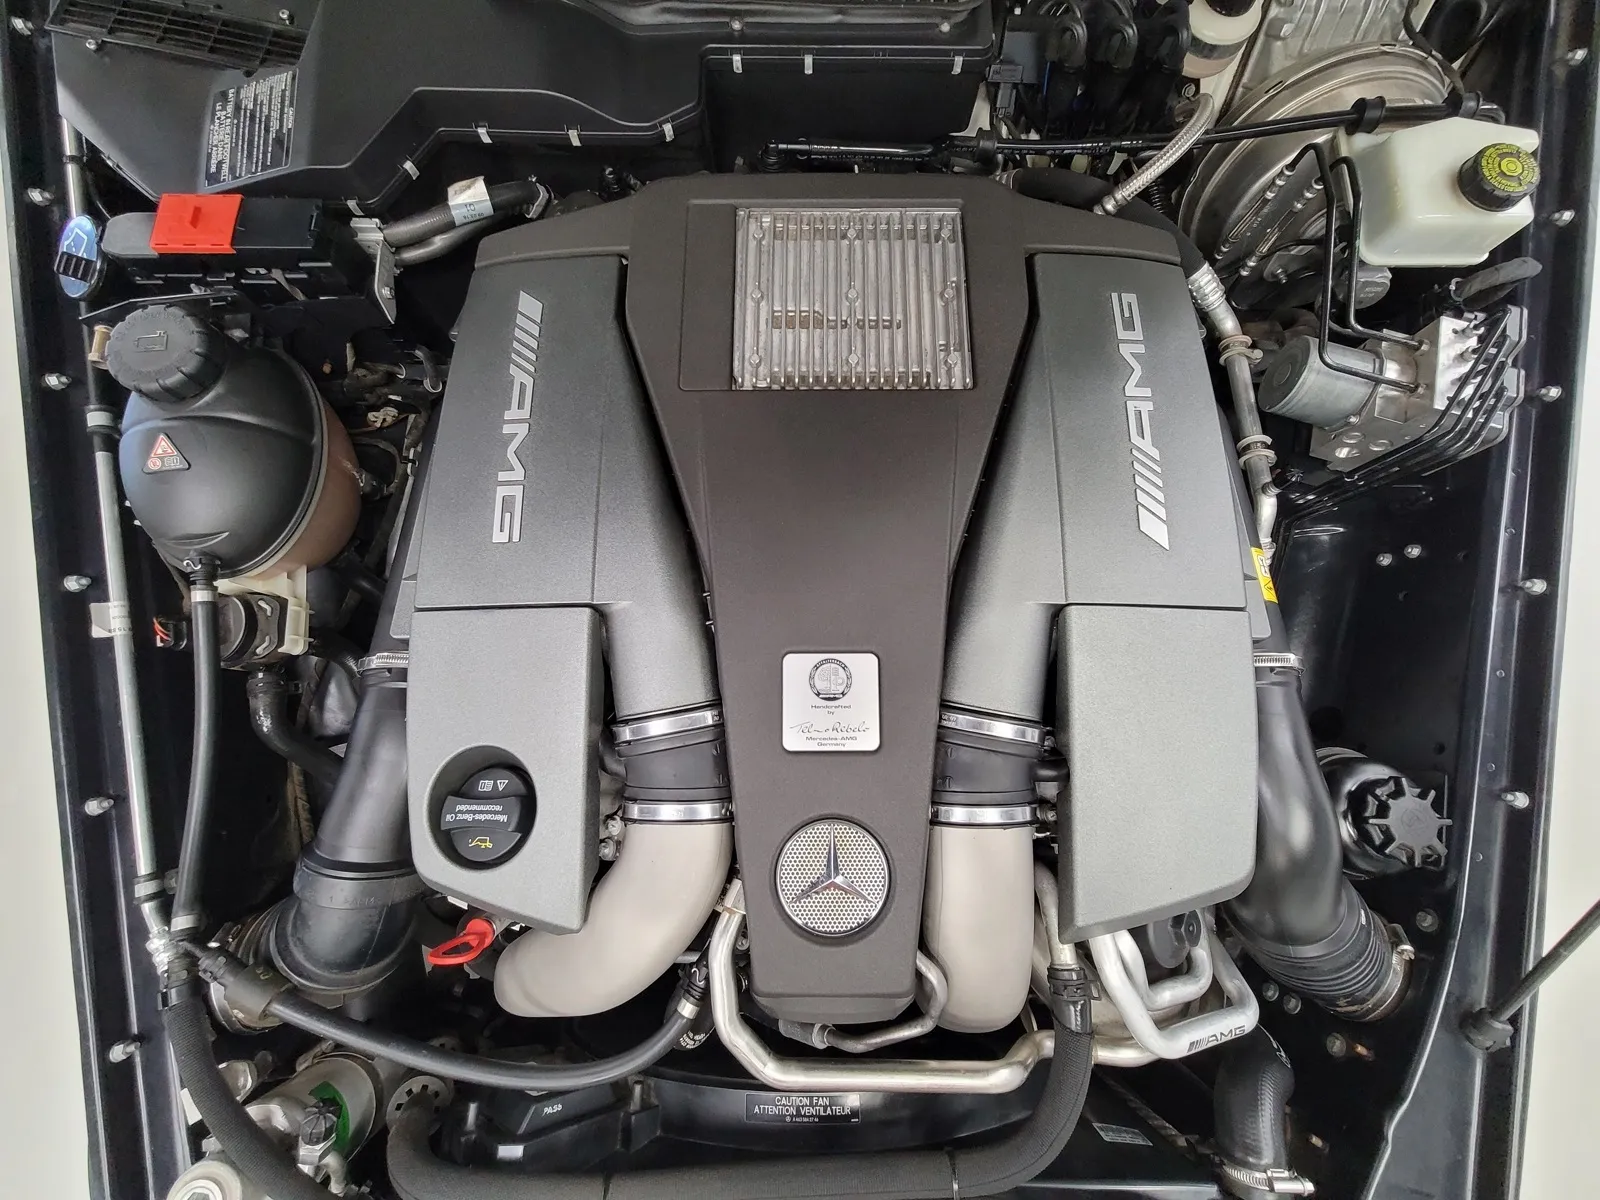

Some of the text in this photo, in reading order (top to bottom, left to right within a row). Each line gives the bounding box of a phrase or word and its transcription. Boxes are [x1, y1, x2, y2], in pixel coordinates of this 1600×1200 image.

[225, 88, 235, 117] BATTERY
[220, 143, 230, 182] FOOTWELL
[1111, 292, 1160, 462] AMG
[492, 363, 535, 543] AMG
[445, 813, 508, 822] Mercedes-Benz Oil
[455, 804, 503, 812] recommended
[1204, 1024, 1246, 1047] AMG
[753, 1105, 851, 1116] ATTENTION VENTILATEUR
[775, 1096, 830, 1106] CAUTION FAN
